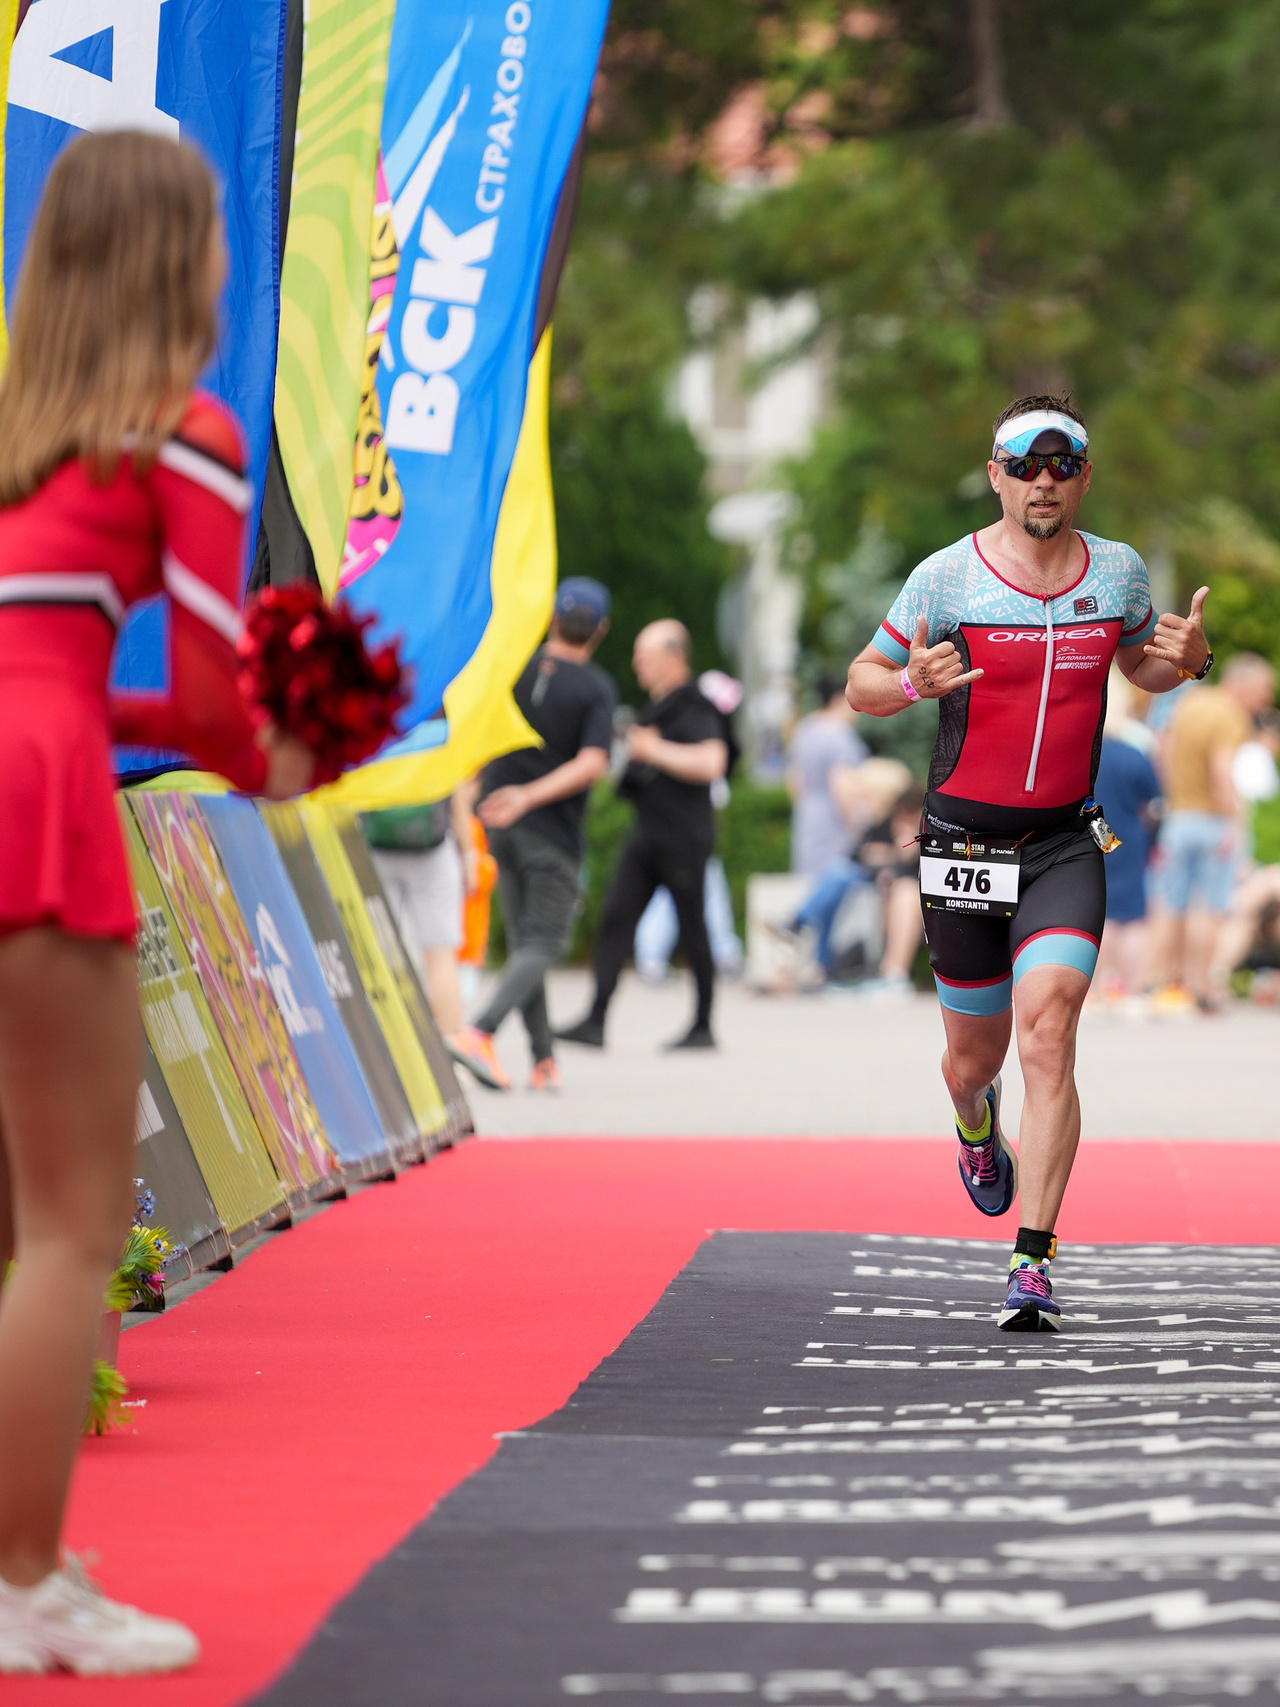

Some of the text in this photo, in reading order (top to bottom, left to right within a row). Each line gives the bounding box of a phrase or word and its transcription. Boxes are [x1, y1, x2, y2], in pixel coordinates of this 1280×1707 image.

[384, 0, 534, 456] ВСК СТРАХОВО
[987, 628, 1107, 642] ORBEA
[952, 842, 966, 850] IRON
[944, 866, 991, 894] 476
[945, 899, 989, 911] KONSTANTIN
